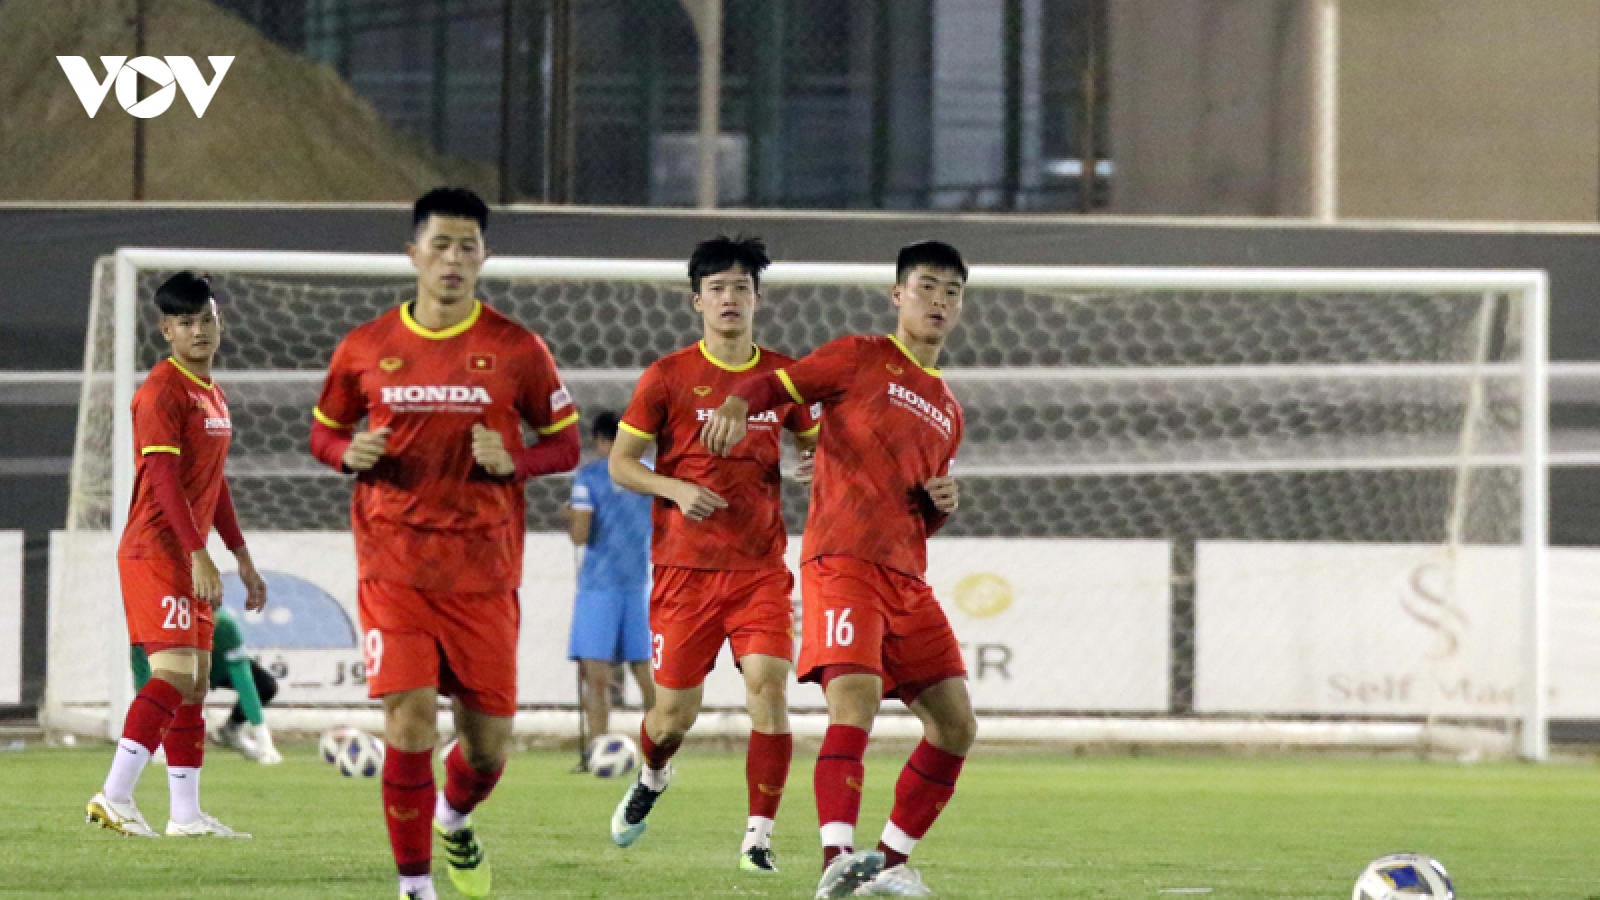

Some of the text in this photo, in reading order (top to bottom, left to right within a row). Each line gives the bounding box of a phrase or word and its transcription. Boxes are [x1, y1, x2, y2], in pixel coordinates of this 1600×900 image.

[381, 386, 492, 404] HONDA
[888, 382, 953, 434] HONDA
[161, 596, 191, 630] 28
[824, 608, 855, 648] 16
